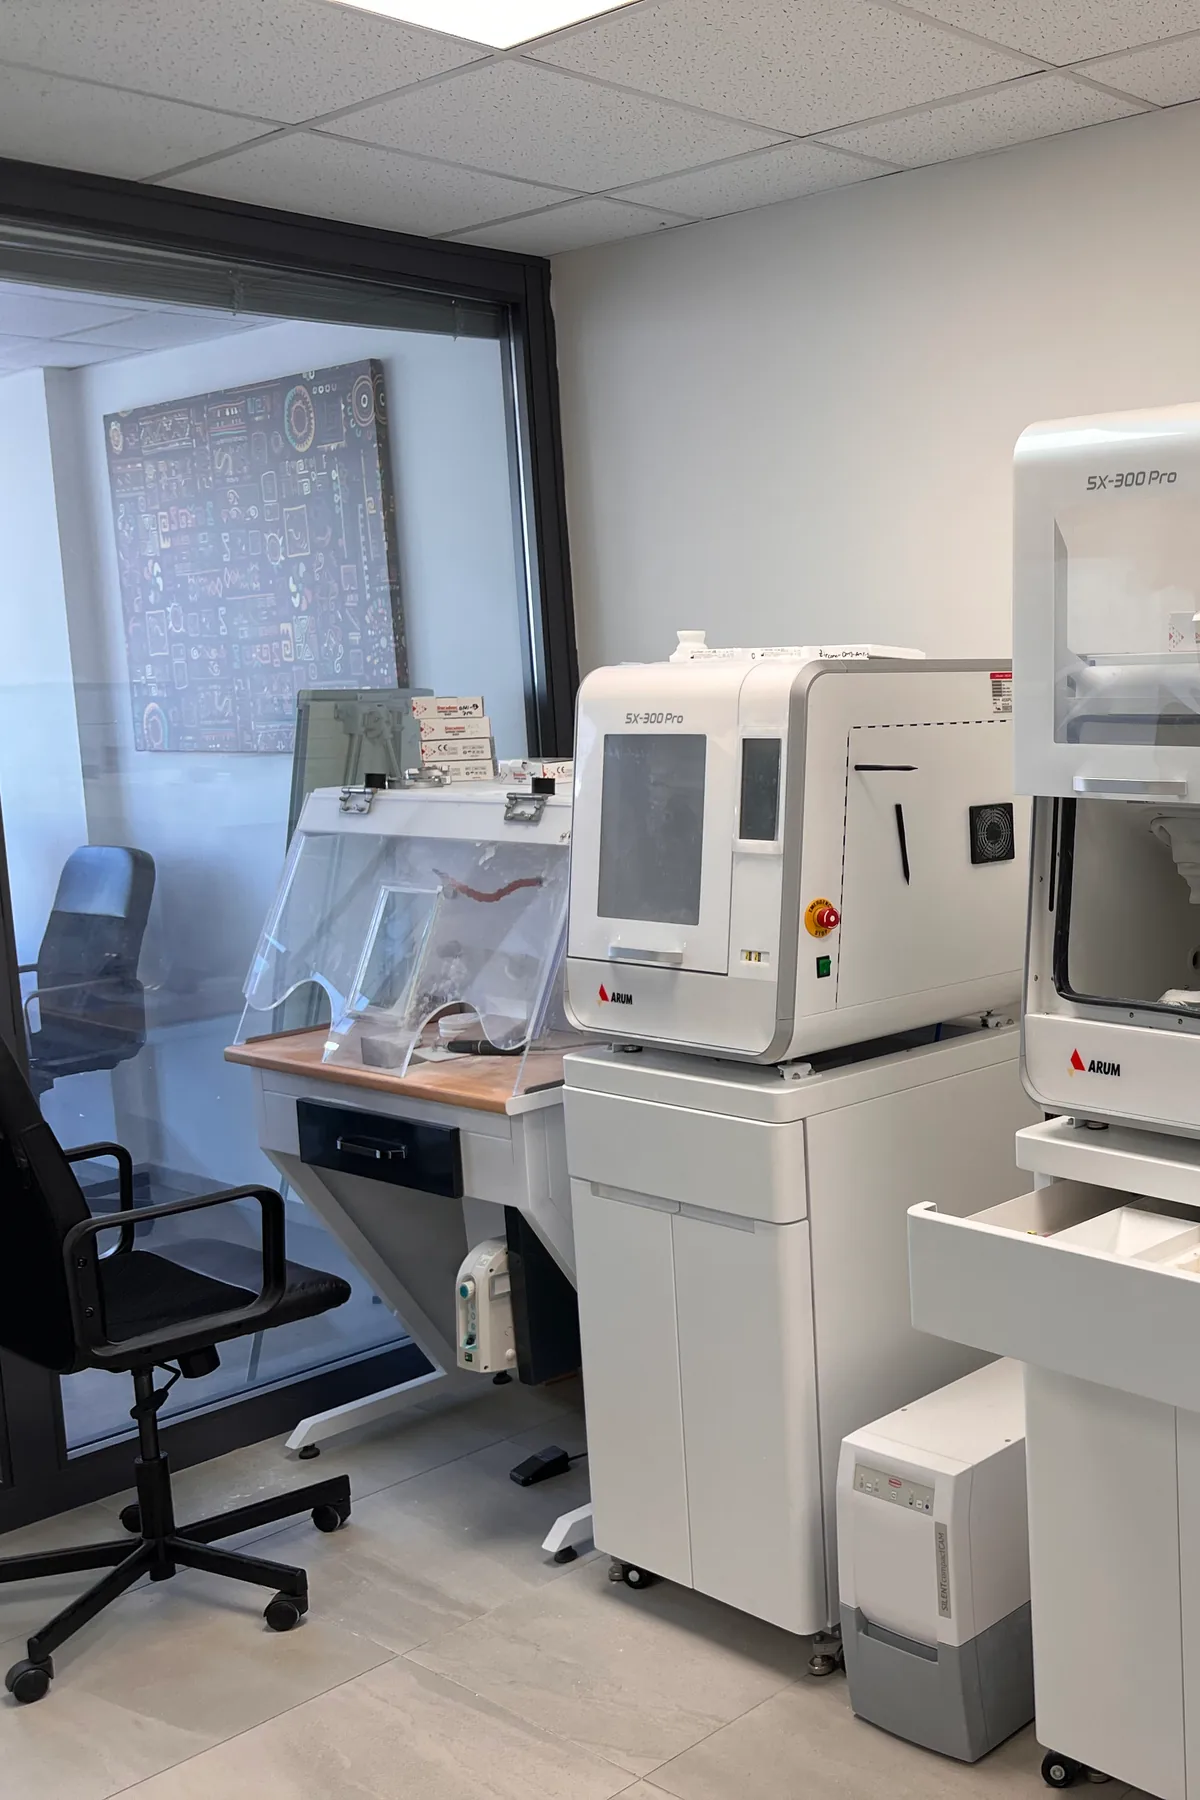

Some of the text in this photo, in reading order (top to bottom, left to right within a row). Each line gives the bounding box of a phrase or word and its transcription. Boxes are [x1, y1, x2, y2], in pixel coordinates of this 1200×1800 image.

[1148, 469, 1178, 485] Pro
[665, 712, 684, 724] Pro
[610, 991, 633, 1005] ARUM
[1087, 1059, 1121, 1077] ARUM
